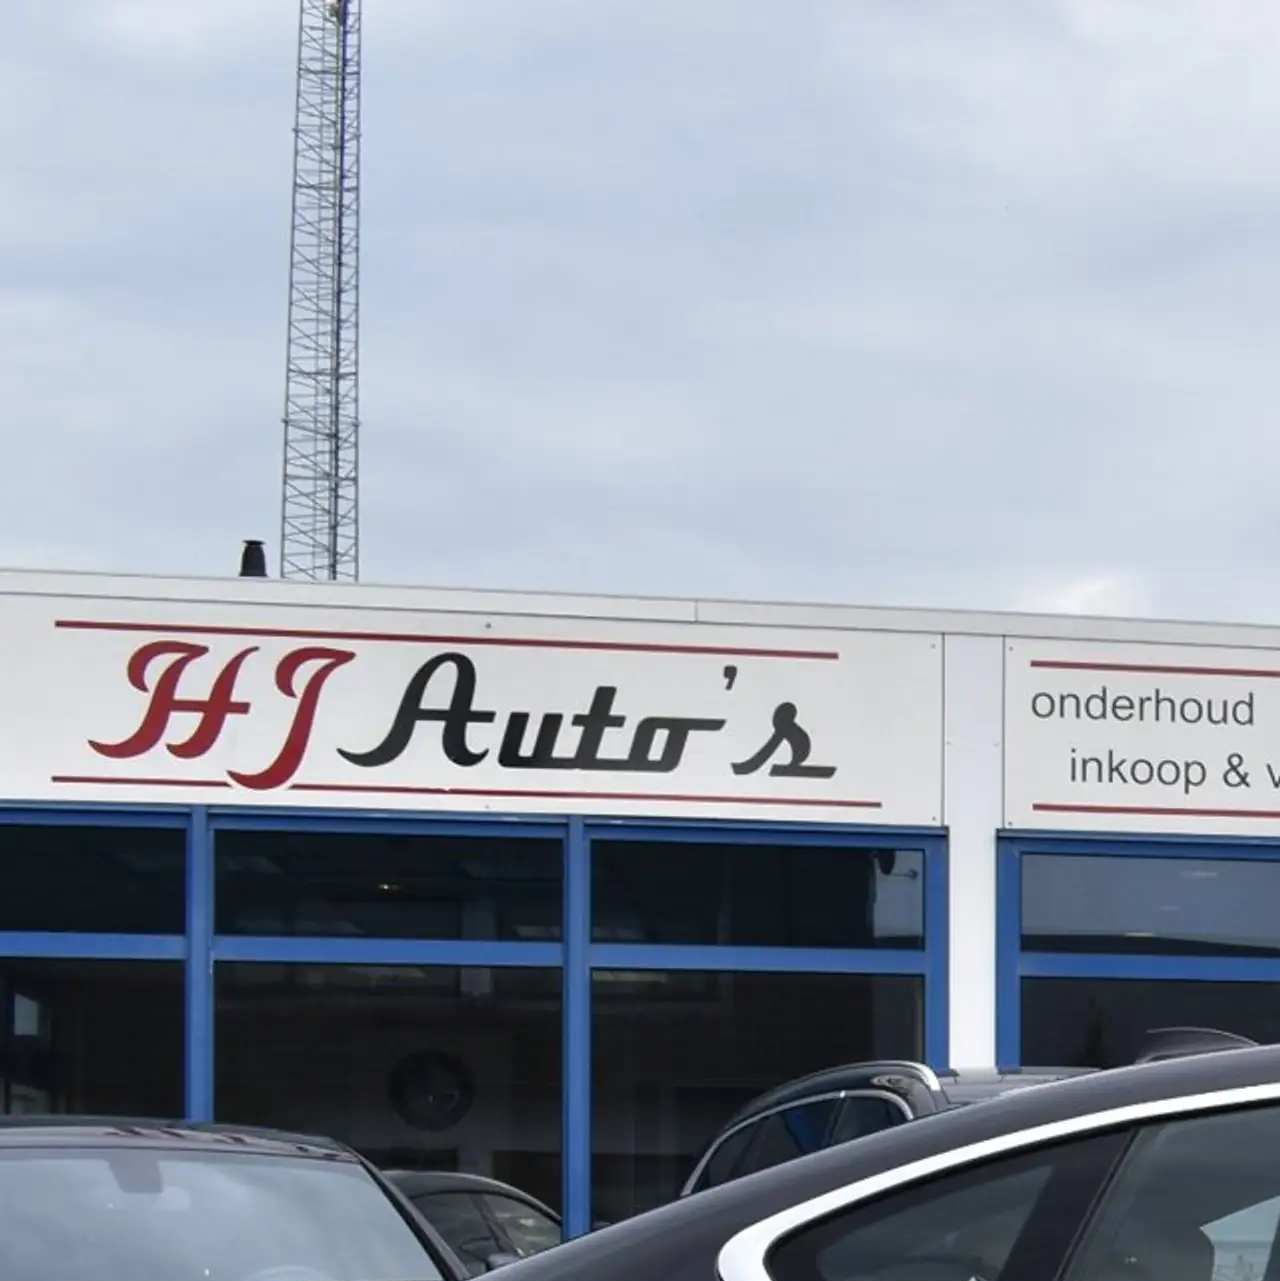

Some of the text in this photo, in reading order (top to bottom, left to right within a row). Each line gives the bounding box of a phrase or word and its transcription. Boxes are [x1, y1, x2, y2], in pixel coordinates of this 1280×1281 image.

[87, 640, 837, 791] HJ Auto's
[1031, 687, 1254, 726] onderhoud
[1070, 749, 1207, 795] inkoop
[1222, 752, 1251, 788] &
